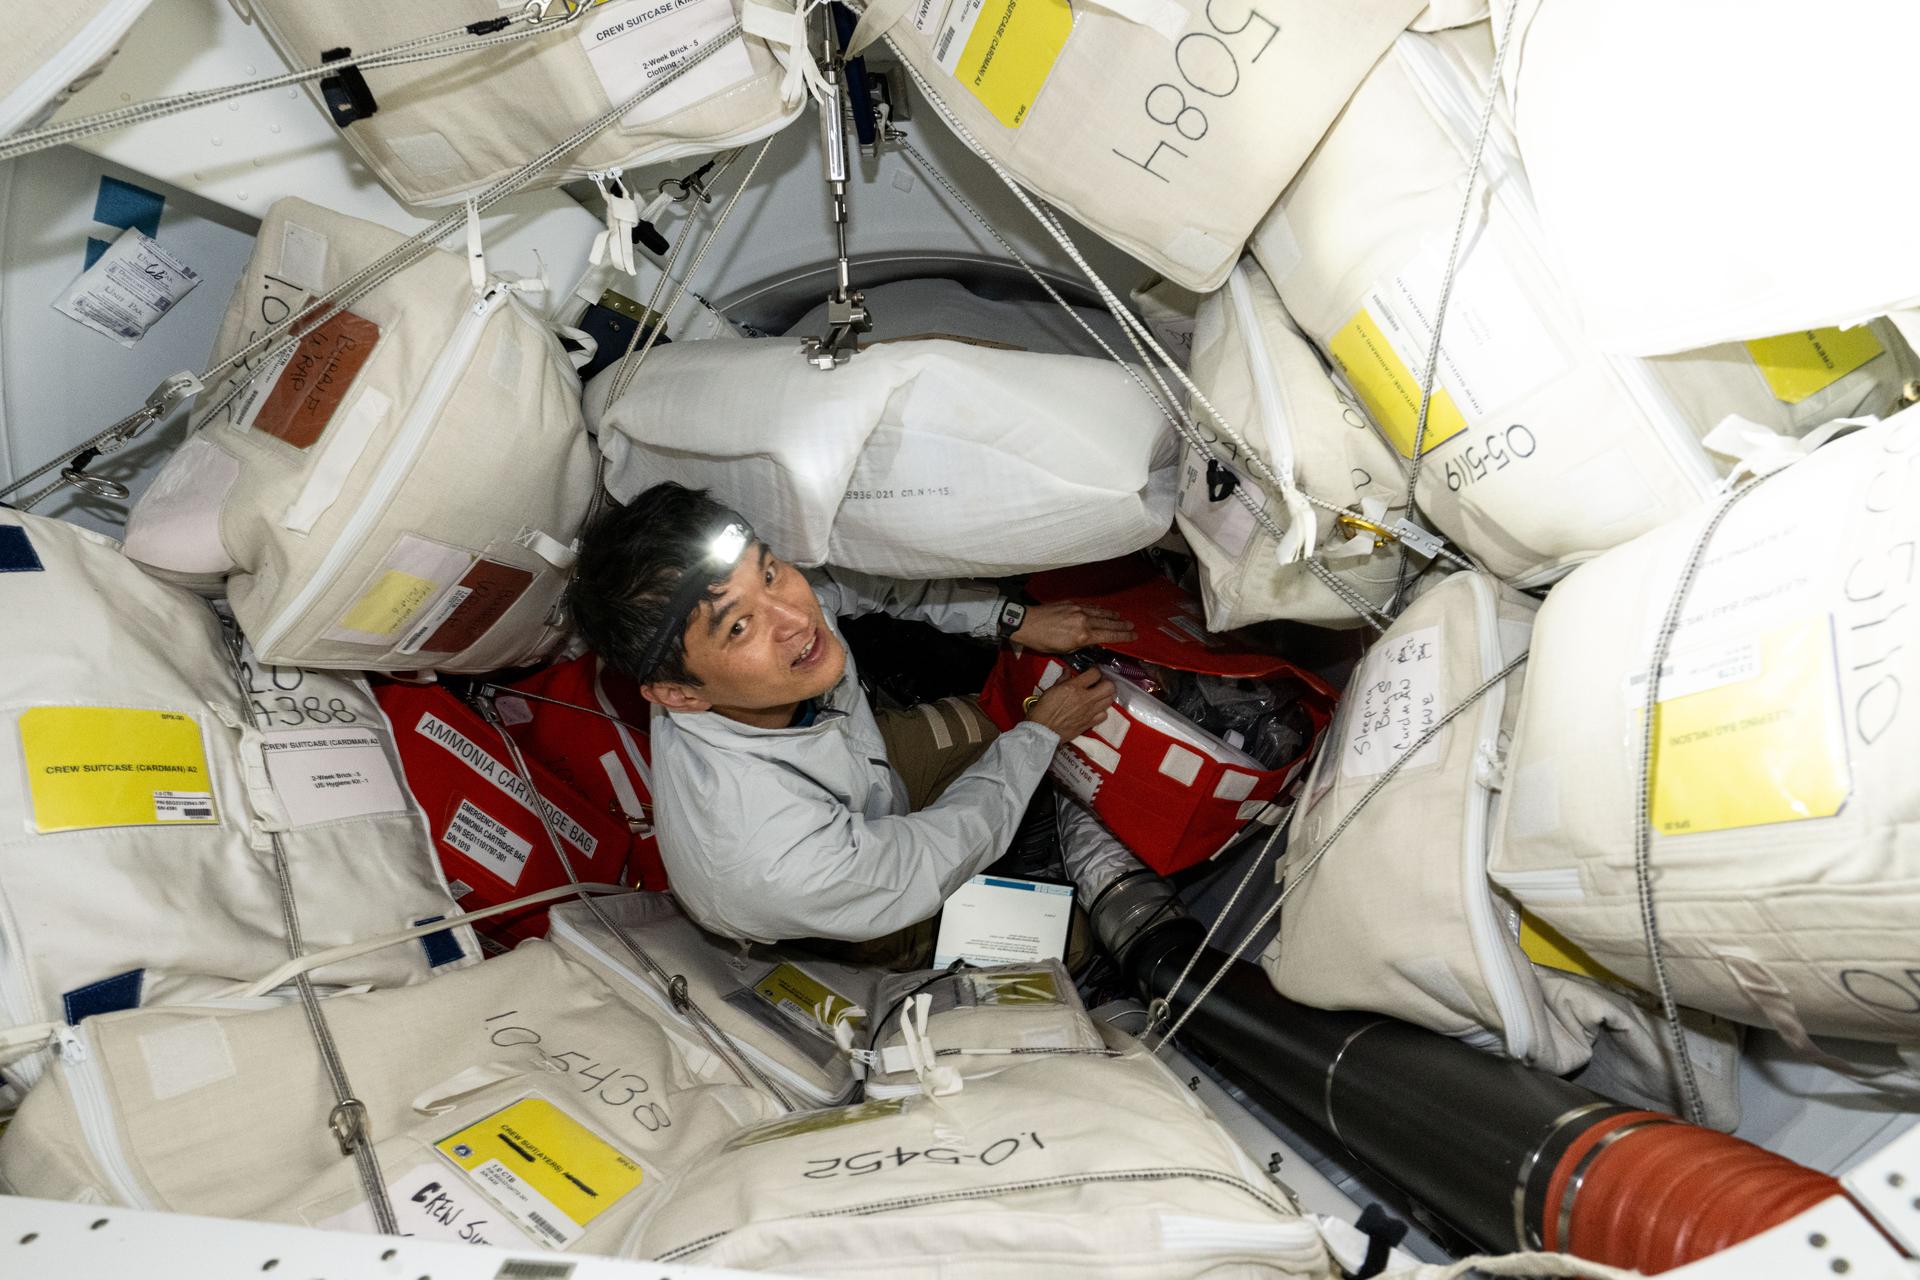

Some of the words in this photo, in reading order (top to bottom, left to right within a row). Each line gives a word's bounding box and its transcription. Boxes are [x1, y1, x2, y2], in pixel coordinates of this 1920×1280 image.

[596, 22, 626, 42] CREW
[626, 3, 674, 28] SUITCASE
[998, 1, 1018, 40] SUITCASE
[642, 54, 669, 70] 2-Week
[669, 45, 688, 58] Brick
[646, 61, 677, 79] Clothing
[978, 37, 1000, 78] (CARDMAN)
[1813, 342, 1834, 369] CREW
[251, 696, 357, 727] 4388
[263, 740, 288, 751] CREW
[289, 739, 328, 750] SUITCASE
[329, 738, 370, 748] (CARDMAN)
[46, 765, 80, 775] CREW
[83, 764, 134, 774] SUITCASE
[136, 763, 186, 775] (CARDMAN)
[187, 764, 198, 774] A2
[312, 773, 335, 782] 2-Week
[335, 772, 352, 780] Brick
[326, 779, 352, 789] Hygiene
[421, 718, 496, 777] AMMONIA
[568, 827, 594, 854] BAG
[451, 822, 463, 834] P/N
[461, 801, 496, 830] EMERGENCY
[495, 824, 509, 839] USE
[446, 831, 457, 843] S/N
[456, 837, 471, 853] 1019
[455, 811, 483, 836] AMMONIA
[483, 826, 514, 857] CARTRIDGE
[513, 848, 527, 864] BAG
[484, 1010, 672, 1132] 1.0-5438
[500, 1124, 522, 1141] CREW
[803, 1131, 1045, 1179] 1.0-5452
